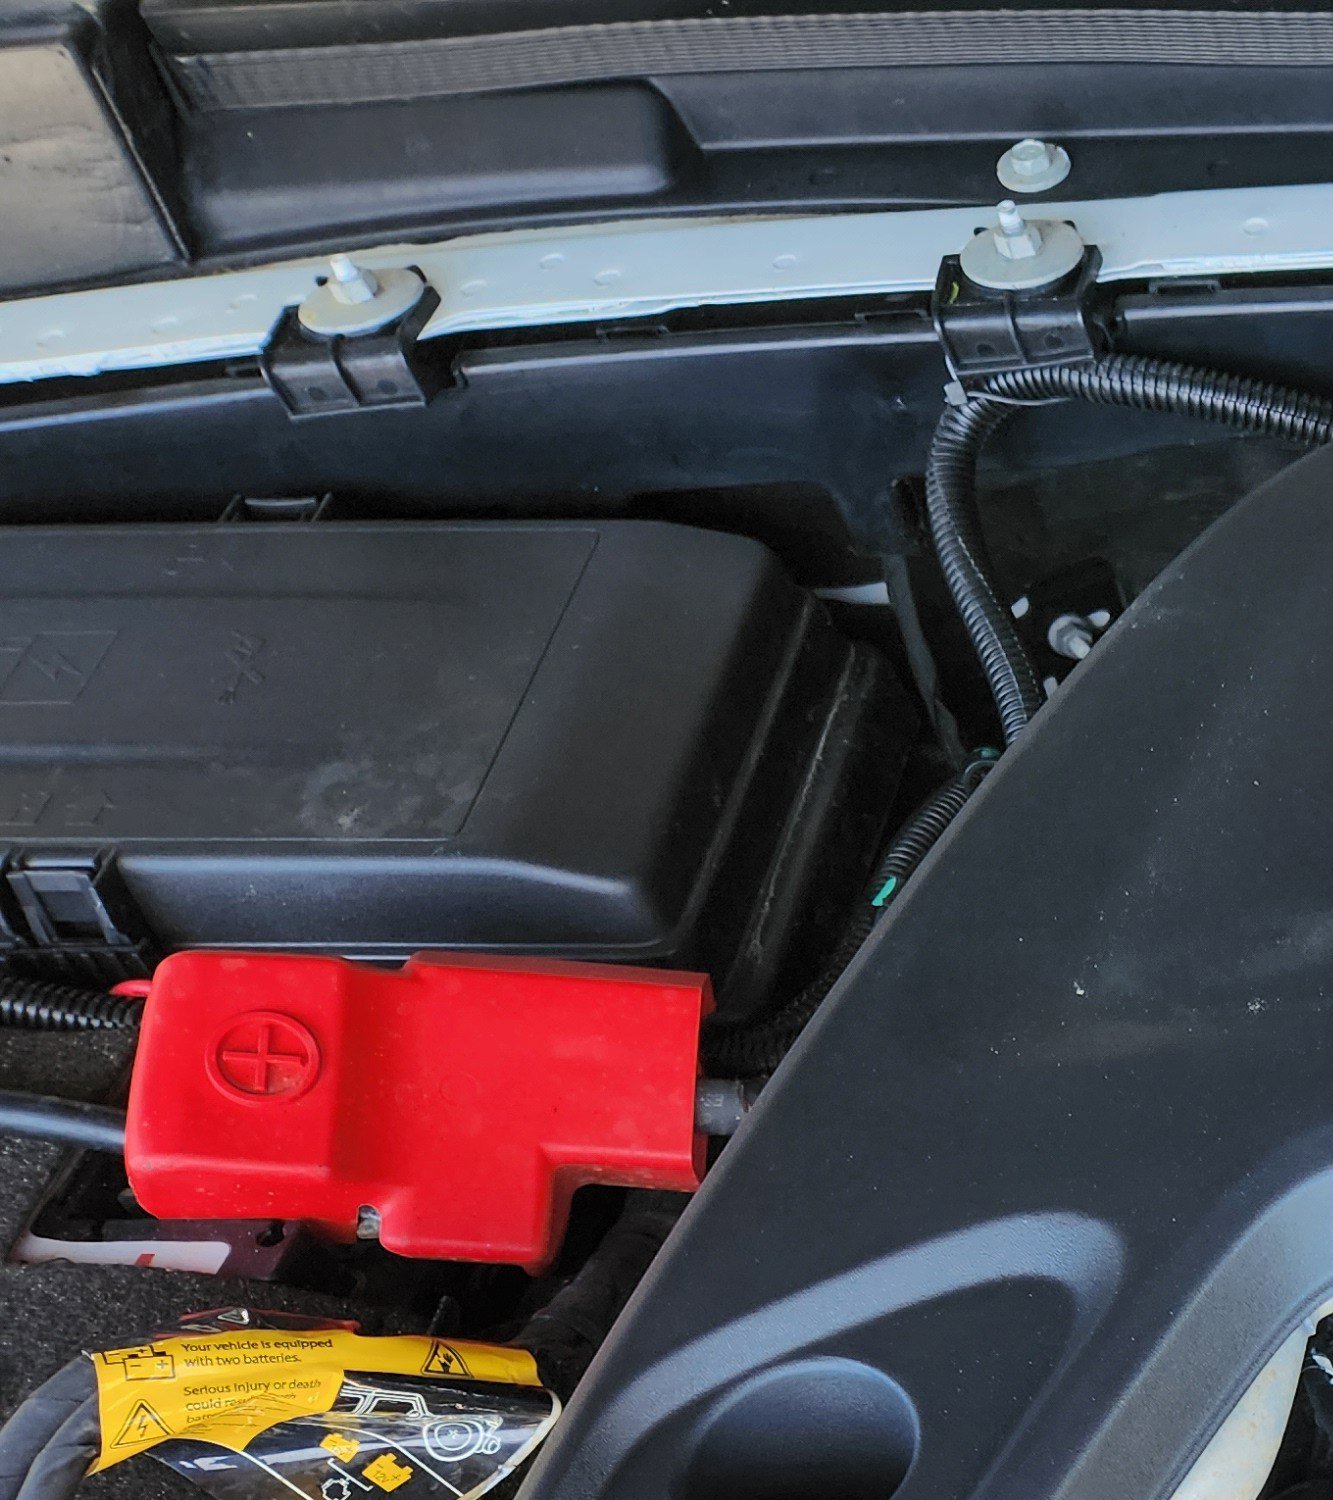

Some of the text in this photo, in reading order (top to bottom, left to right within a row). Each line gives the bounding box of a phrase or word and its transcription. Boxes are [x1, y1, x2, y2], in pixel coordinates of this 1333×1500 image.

[180, 1338, 334, 1353] Your vehicle is equipped
[184, 1351, 302, 1368] with two batteries.
[183, 1378, 322, 1397] Serious injury or death
[185, 1397, 222, 1412] could
